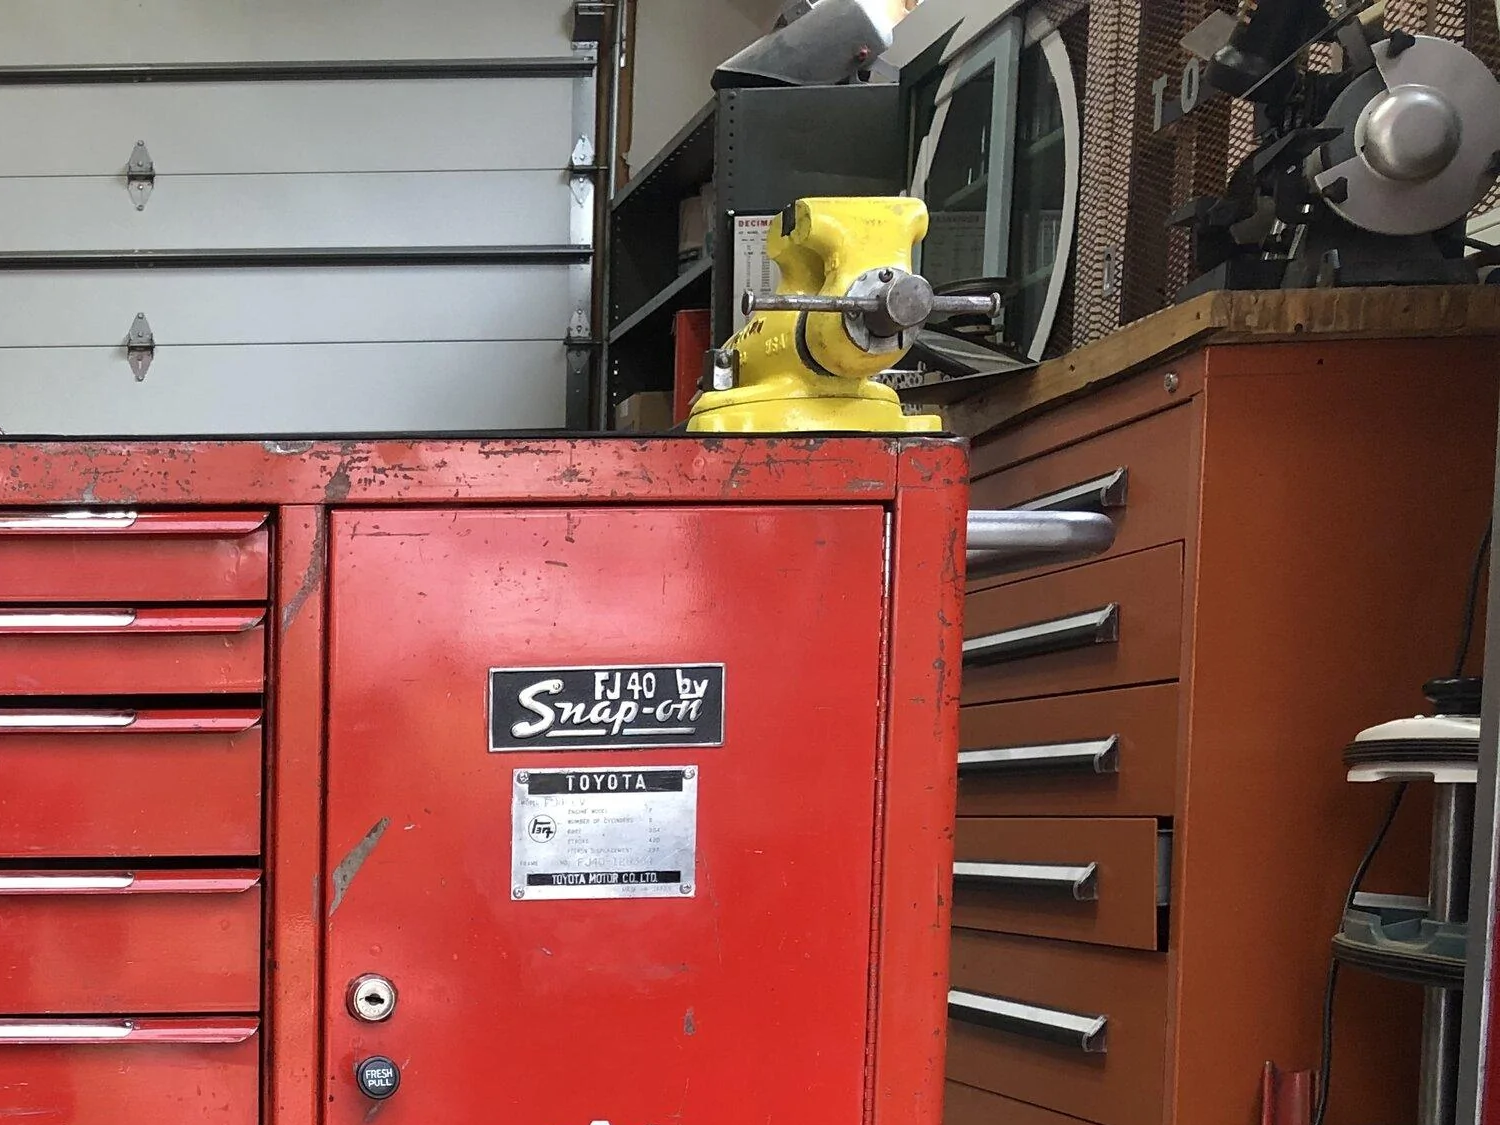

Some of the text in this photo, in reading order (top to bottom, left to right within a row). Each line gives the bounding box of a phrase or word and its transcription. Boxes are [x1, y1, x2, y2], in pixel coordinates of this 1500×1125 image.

[675, 669, 709, 699] by
[511, 678, 703, 738] Snap-on
[566, 774, 646, 792] TOYOTA
[552, 875, 586, 885] TOYOTA
[588, 873, 619, 884] MOTOR
[365, 1068, 393, 1079] FRESH
[368, 1078, 392, 1087] PULL
